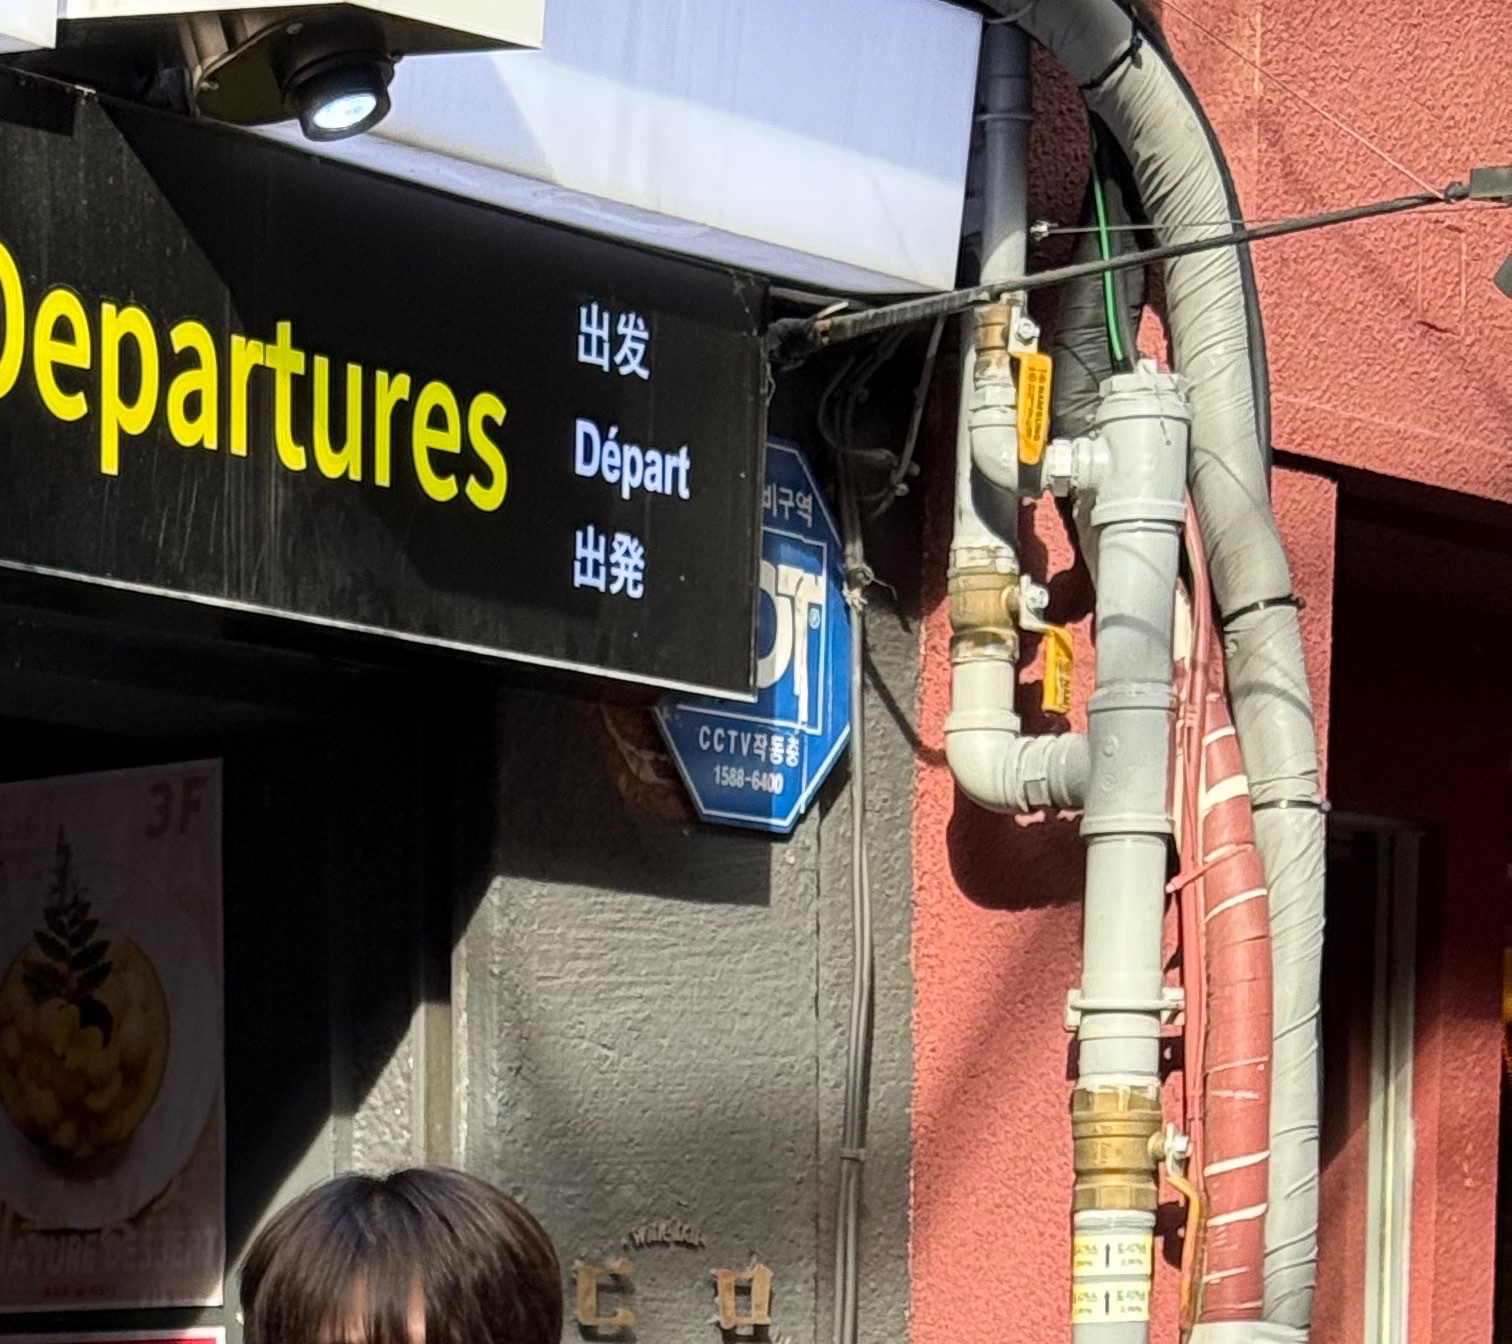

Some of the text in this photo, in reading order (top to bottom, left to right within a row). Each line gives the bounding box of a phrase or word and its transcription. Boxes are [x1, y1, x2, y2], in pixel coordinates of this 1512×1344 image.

[576, 301, 651, 380] 出发
[574, 418, 691, 500] Départ
[573, 525, 646, 600] 出発
[714, 764, 785, 796] 1588-6400
